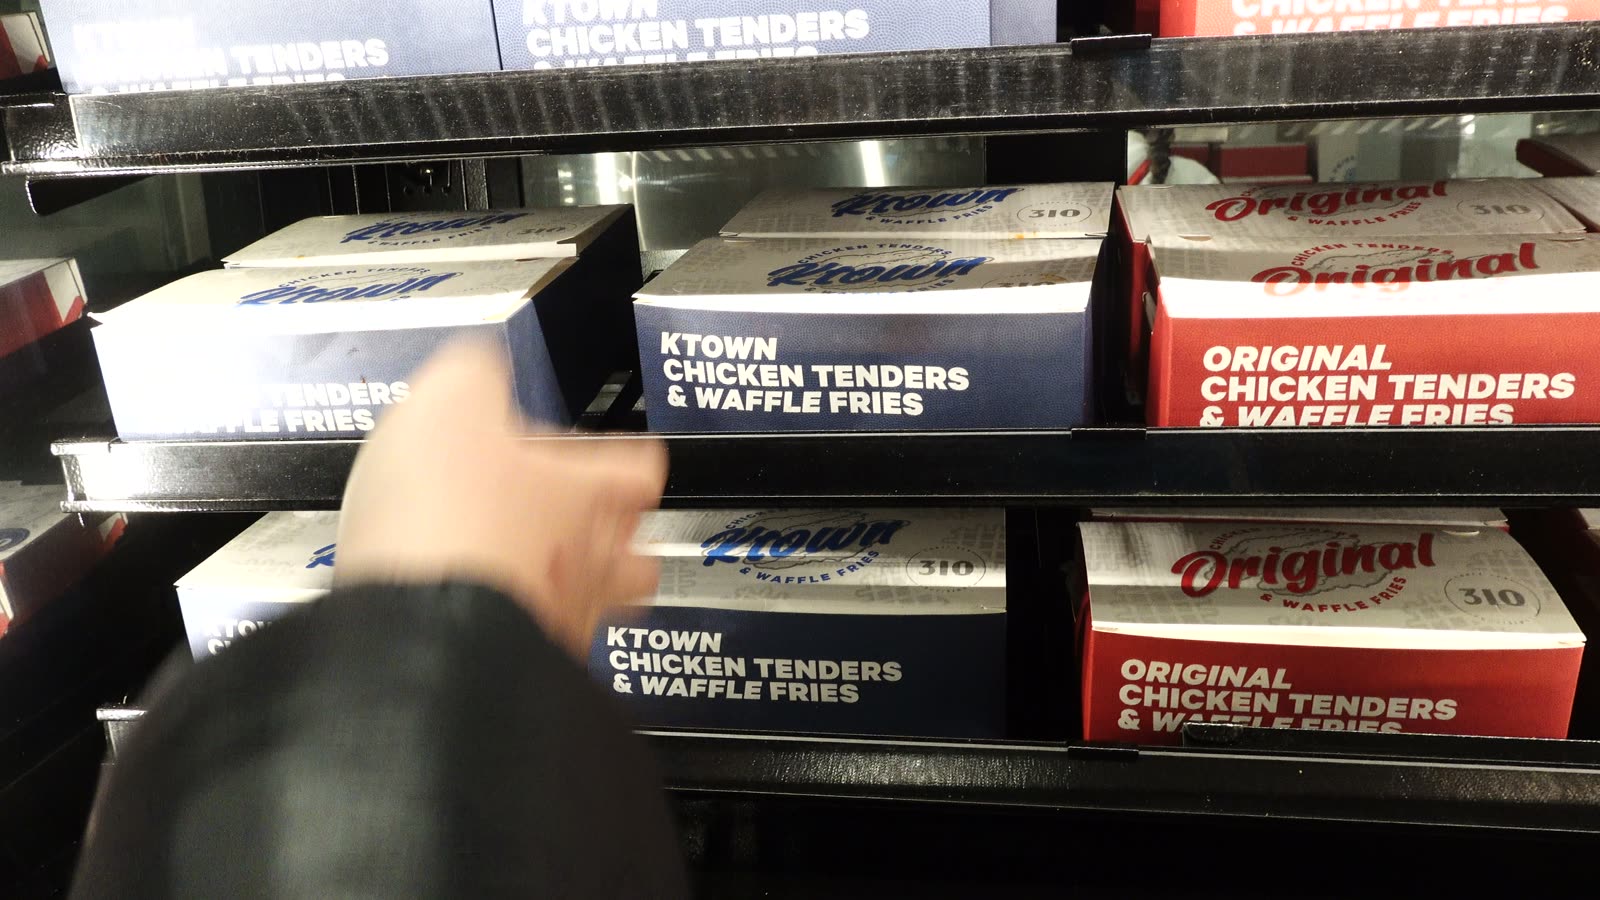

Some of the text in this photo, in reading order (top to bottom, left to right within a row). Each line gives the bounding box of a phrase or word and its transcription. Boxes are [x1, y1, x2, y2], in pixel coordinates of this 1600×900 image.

[522, 0, 658, 25] KTOWN
[526, 9, 870, 57] CHICKEN TENDERS
[230, 38, 389, 75] TENDERS
[831, 187, 1019, 218] Ktown
[880, 216, 947, 225] WAFFLE
[953, 204, 994, 221] FRIES
[1028, 208, 1081, 219] 310
[1205, 179, 1448, 221] Original
[1308, 215, 1387, 227] WAFFLE
[1392, 201, 1422, 221] FRIES
[1470, 203, 1531, 217] 310
[798, 243, 953, 264] CHICKEN TENDERS
[1291, 243, 1346, 267] CHICKEN
[767, 256, 988, 287] Ktown
[1250, 242, 1541, 297] Original
[661, 331, 778, 361] KTOWN
[1202, 344, 1393, 372] ORIGINAL
[663, 358, 970, 391] CHICKEN TENDERS
[1200, 372, 1577, 402] CHICKEN TENDERS
[666, 384, 924, 417] & WAFFLE FRIES
[1200, 403, 1515, 427] & WAFFLE FRIES
[284, 408, 376, 433] FRIES
[700, 520, 906, 567] Ktown
[756, 571, 832, 584] WAFFLE
[837, 549, 880, 577] FRIES
[918, 560, 975, 577] 310
[1171, 532, 1437, 598] Original
[1282, 599, 1370, 613] WAFFLE
[1372, 575, 1408, 606] FRIES
[1458, 587, 1526, 608] 310
[606, 626, 722, 653] KTOWN
[609, 650, 903, 682] CHICKEN TENDERS
[1120, 658, 1292, 690] ORIGINAL
[612, 673, 860, 703] & WAFFLE FRIES
[1119, 684, 1279, 713] CHICKEN
[1289, 693, 1458, 721] TENDERS
[1117, 708, 1141, 732] &
